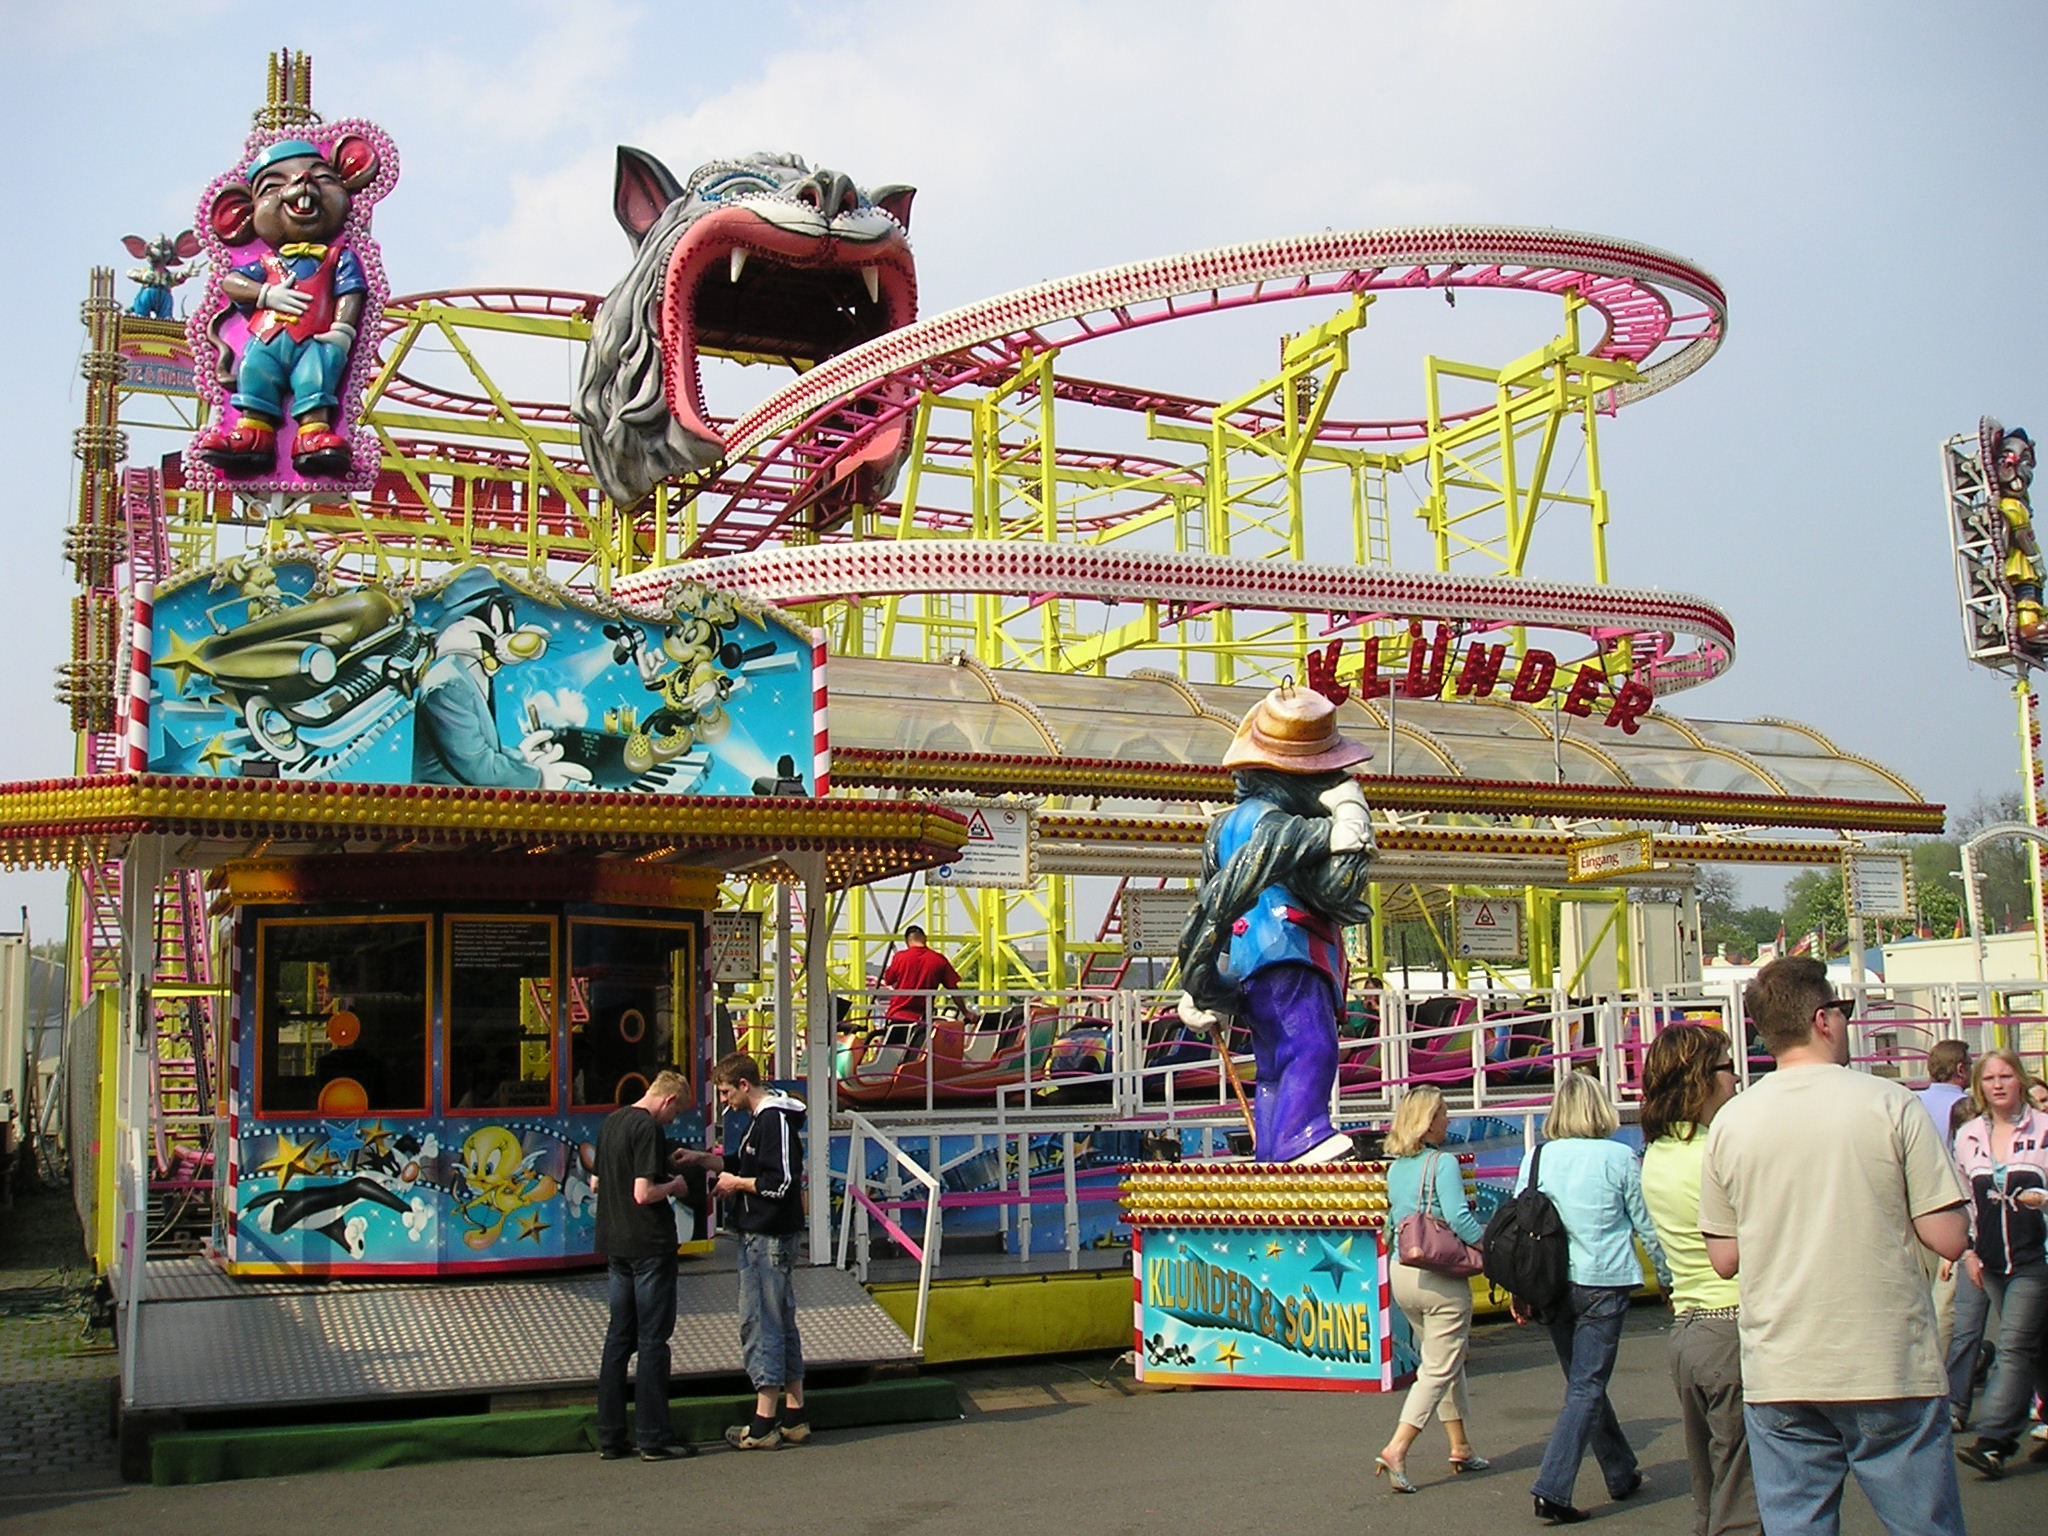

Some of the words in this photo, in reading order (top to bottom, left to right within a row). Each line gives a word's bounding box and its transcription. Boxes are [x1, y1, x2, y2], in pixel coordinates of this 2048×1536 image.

[1307, 622, 1653, 735] KLÜNDER
[1581, 853, 1619, 870] Eingang
[1149, 1244, 1252, 1327] KLÜNDER
[1260, 1287, 1277, 1337] &
[1285, 1283, 1368, 1352] SÖHNE
